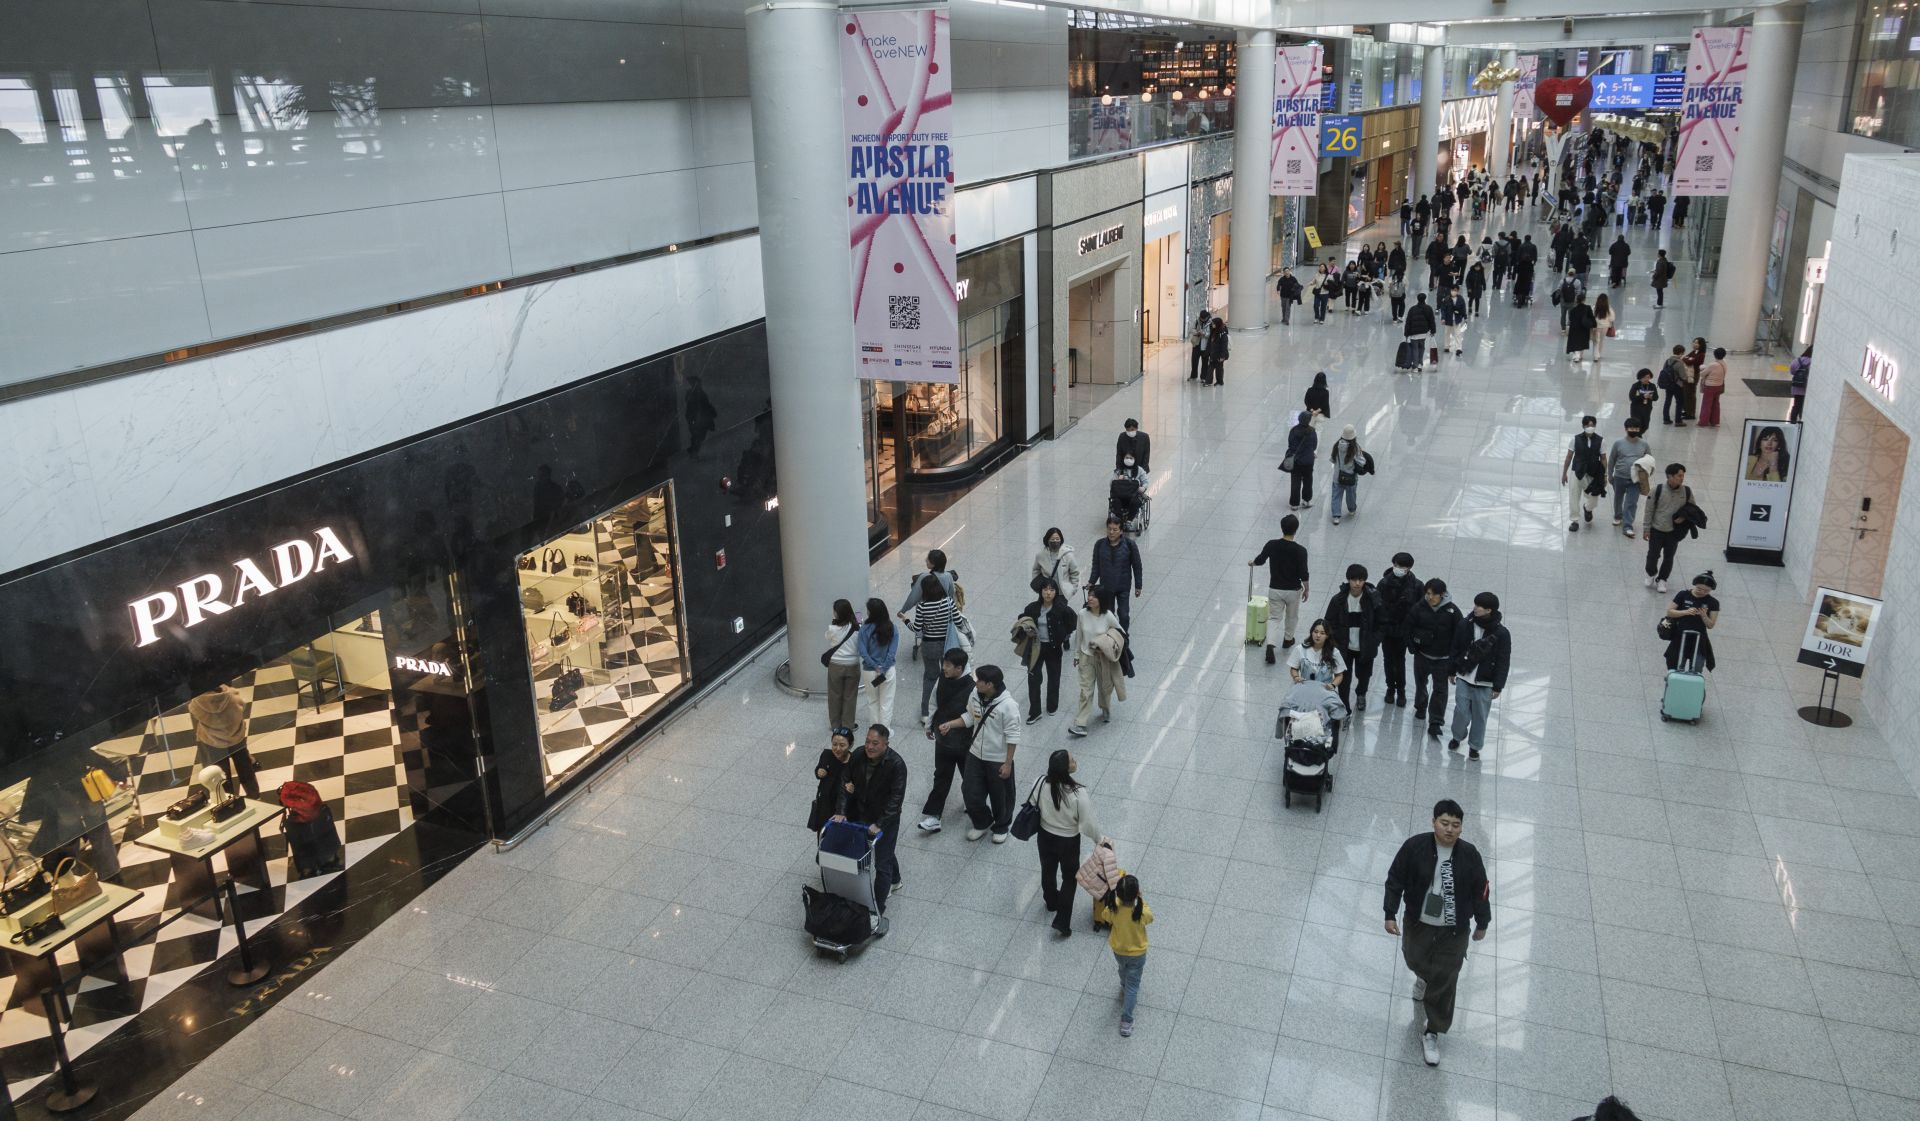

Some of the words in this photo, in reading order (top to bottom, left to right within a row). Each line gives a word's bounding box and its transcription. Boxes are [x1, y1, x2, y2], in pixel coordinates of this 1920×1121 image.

[861, 35, 897, 47] make
[1606, 95, 1632, 105] 12-25
[1686, 87, 1742, 103] AIRSTAR
[1276, 98, 1319, 113] AIRSTAR
[1686, 104, 1737, 119] AVENUE
[1277, 113, 1316, 127] AVENUE
[851, 133, 881, 143] INCHEON
[911, 133, 930, 142] DUTY
[931, 132, 949, 142] FREE
[1325, 127, 1358, 151] 26
[851, 144, 951, 179] AIRSTAR
[857, 181, 947, 216] AVENUE
[1079, 234, 1098, 256] SAINT
[1098, 224, 1124, 248] LAURENT
[1861, 344, 1897, 402] DIOR
[128, 526, 353, 648] PRADA
[1817, 641, 1852, 657] DIOR
[395, 655, 452, 677] PRADA
